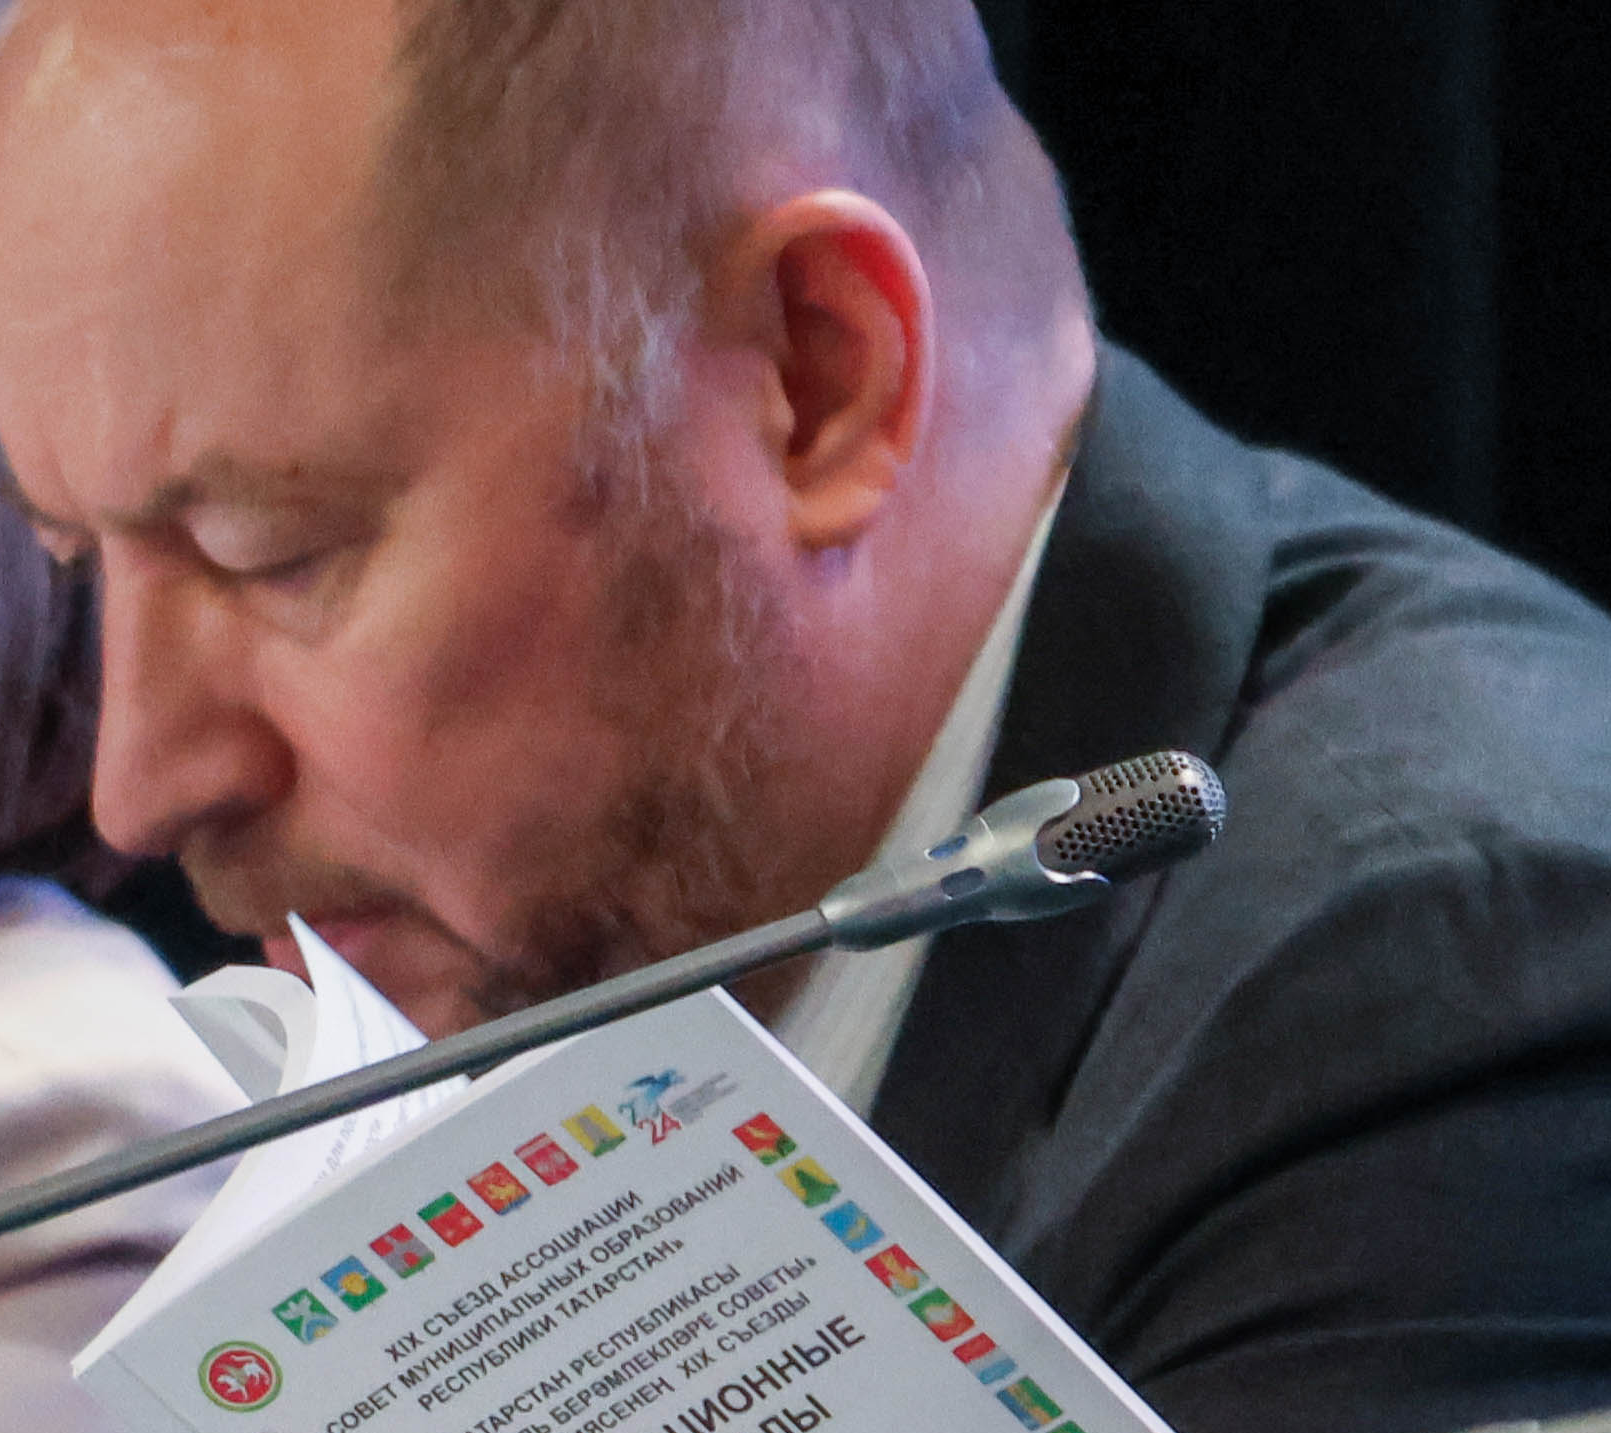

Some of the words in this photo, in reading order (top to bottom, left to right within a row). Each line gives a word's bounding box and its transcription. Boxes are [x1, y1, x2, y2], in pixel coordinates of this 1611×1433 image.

[400, 1260, 593, 1390] МУНИЦИПАЛЬНЫХ
[590, 1164, 747, 1263] ОБРАЗОВАНИЙ
[418, 1315, 559, 1413] РЕСПУБЛИКИ
[554, 1238, 685, 1320] ТАТАРСТАН»
[422, 1284, 505, 1338] СЪЕЗД
[500, 1190, 644, 1289] АССОЦИАЦИИ
[575, 1264, 741, 1376] РЕСПУБЛИКАСЫ
[717, 1253, 818, 1320] СОВЕТЫ»
[718, 1291, 812, 1355] СЪЕЗДЫ
